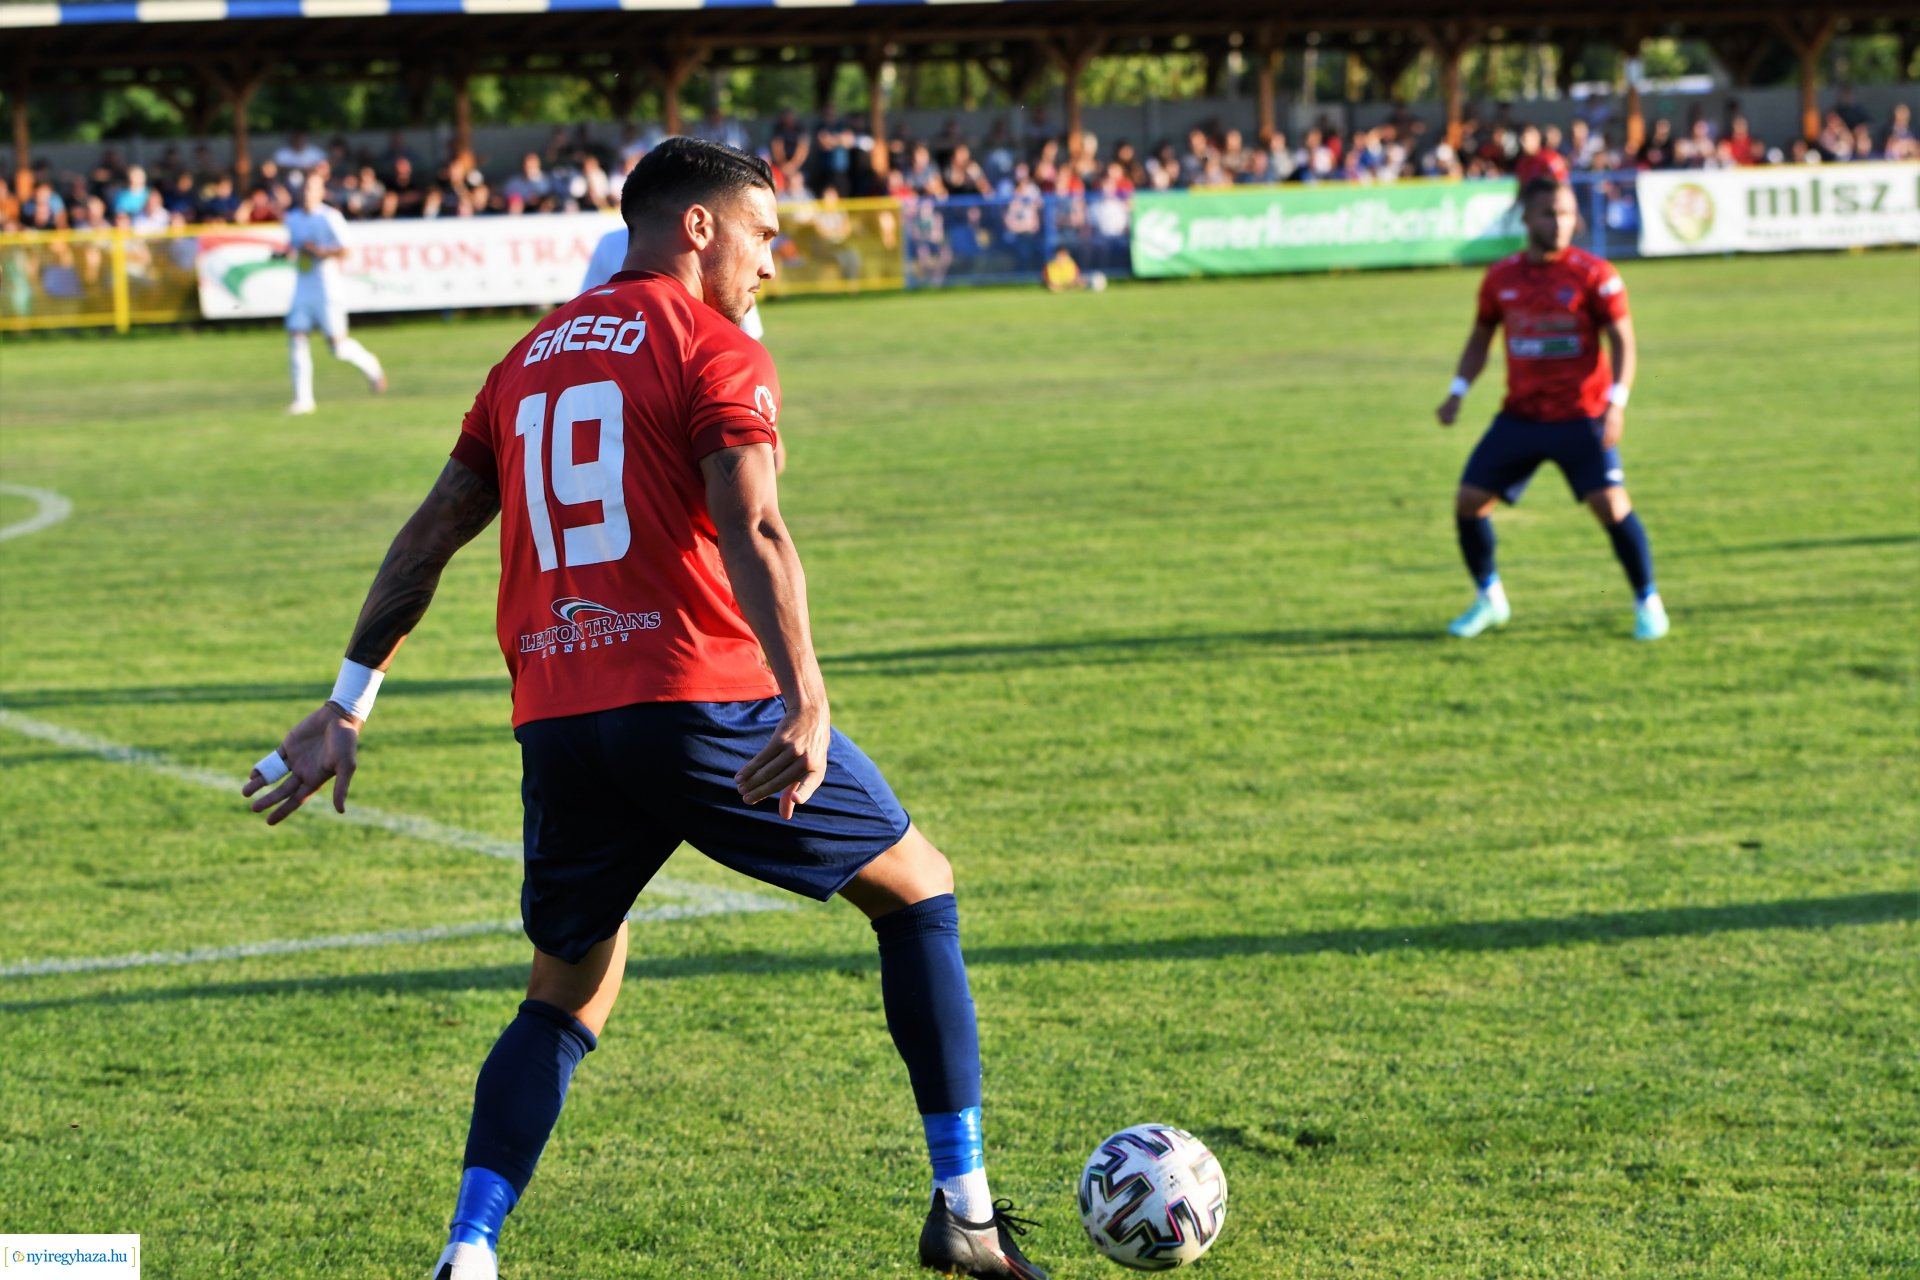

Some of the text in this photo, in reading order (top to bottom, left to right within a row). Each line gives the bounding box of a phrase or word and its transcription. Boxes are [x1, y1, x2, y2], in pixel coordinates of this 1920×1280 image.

[1746, 177, 1920, 217] mlsz.
[504, 232, 594, 268] TRA
[523, 311, 647, 368] GRESÓ
[515, 380, 632, 573] 19
[585, 611, 661, 638] TRANS
